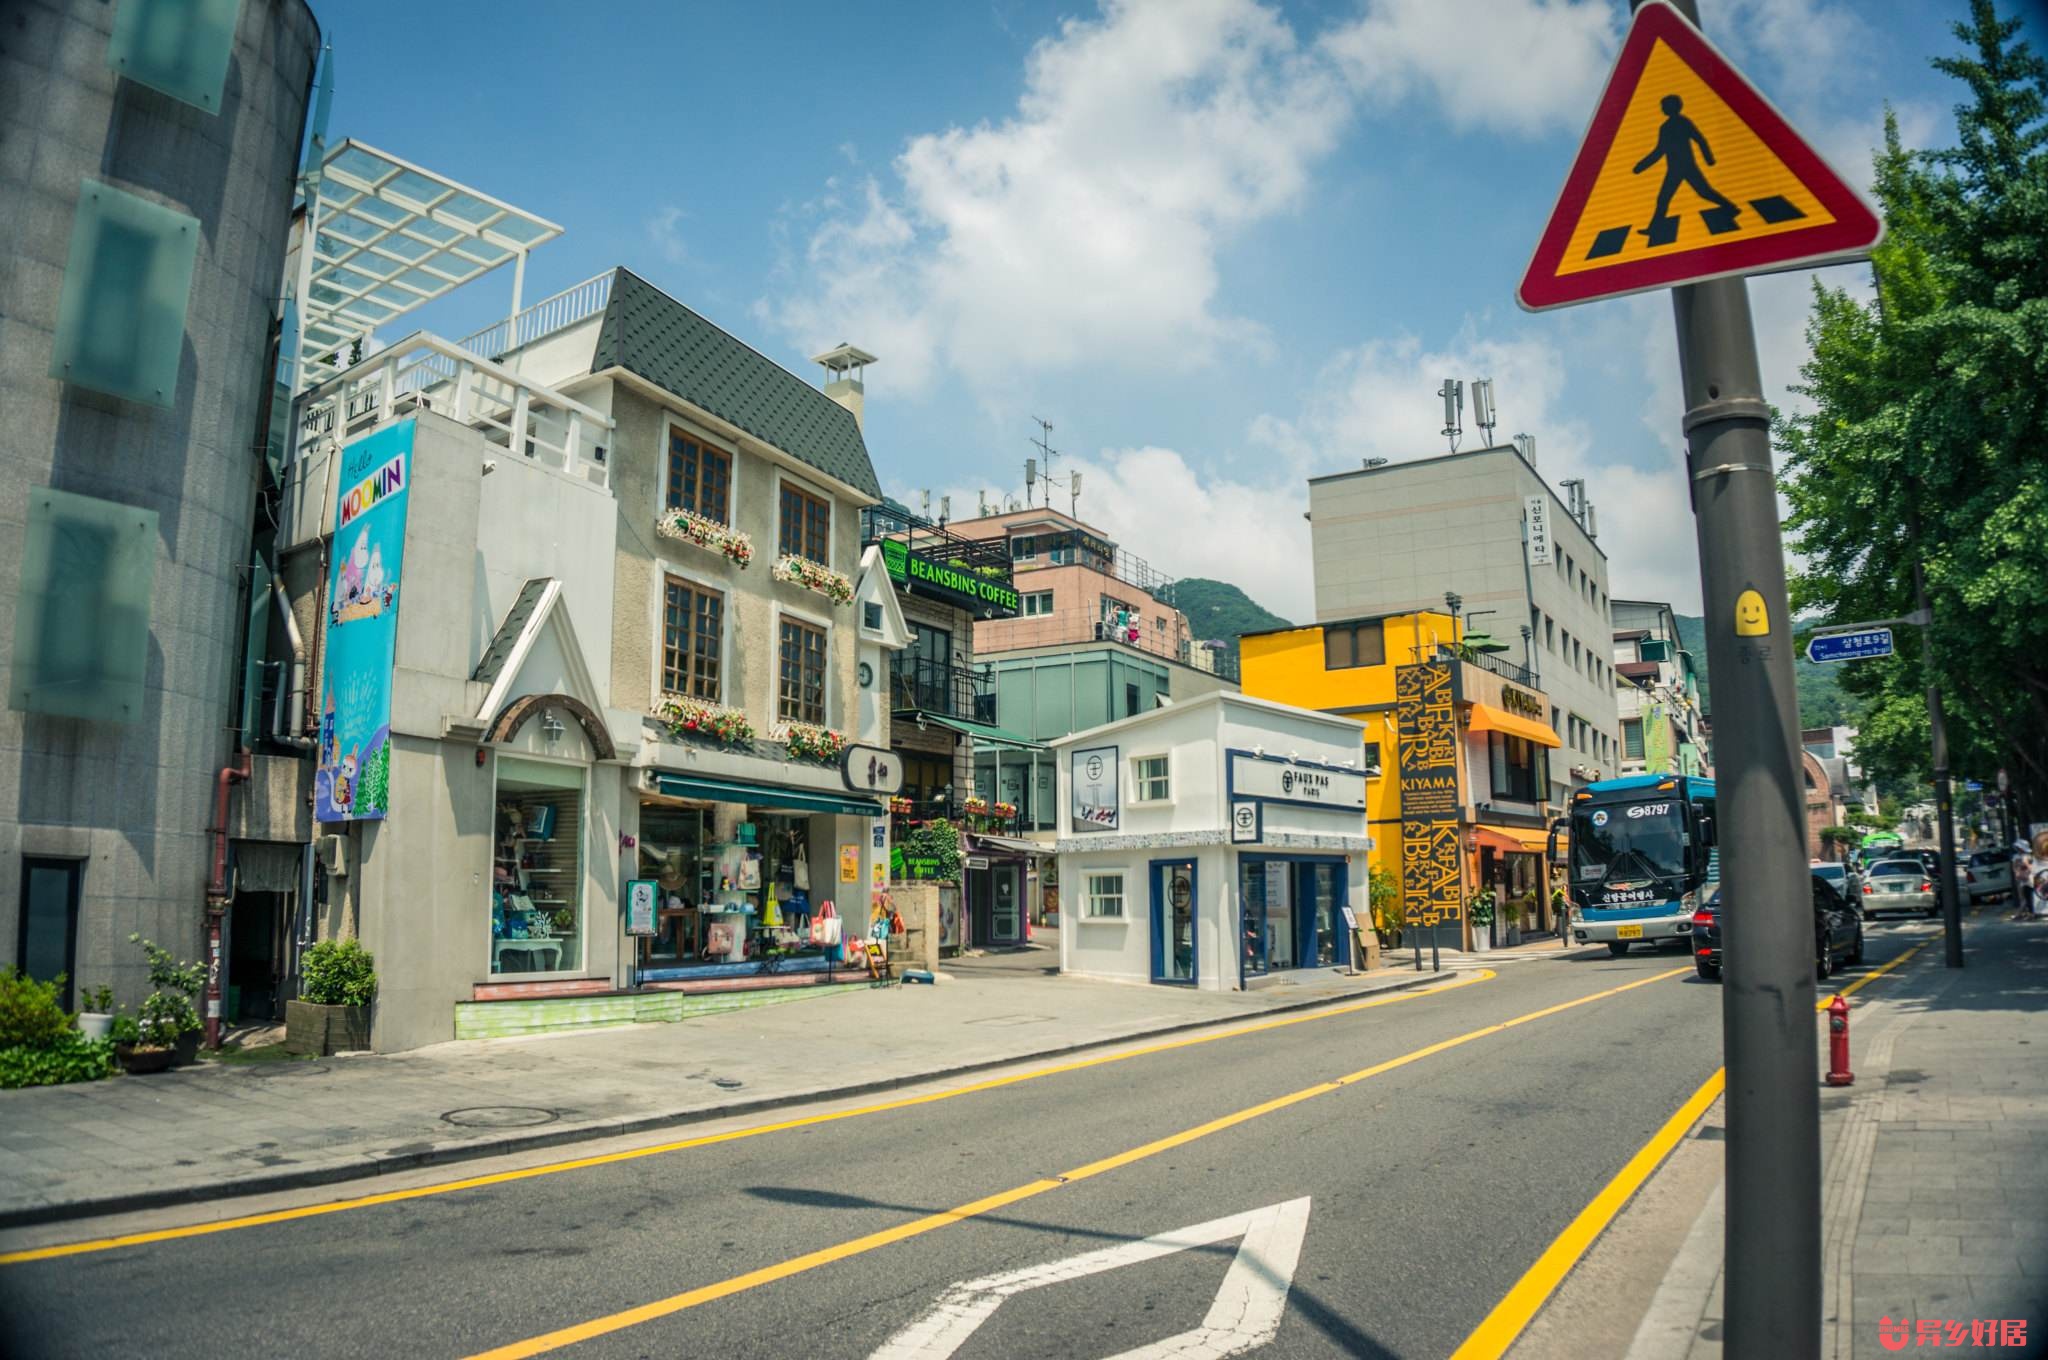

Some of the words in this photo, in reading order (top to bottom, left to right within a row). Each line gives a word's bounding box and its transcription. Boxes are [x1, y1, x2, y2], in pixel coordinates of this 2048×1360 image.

[348, 451, 372, 478] Hello
[341, 459, 401, 526] MOOMIN
[911, 558, 977, 596] BEANSBINS
[979, 582, 1018, 609] COFFEE
[1294, 771, 1313, 785] FAUX
[1315, 775, 1328, 788] PAS
[1401, 776, 1456, 791] KIYAMA
[1644, 804, 1670, 816] 8797
